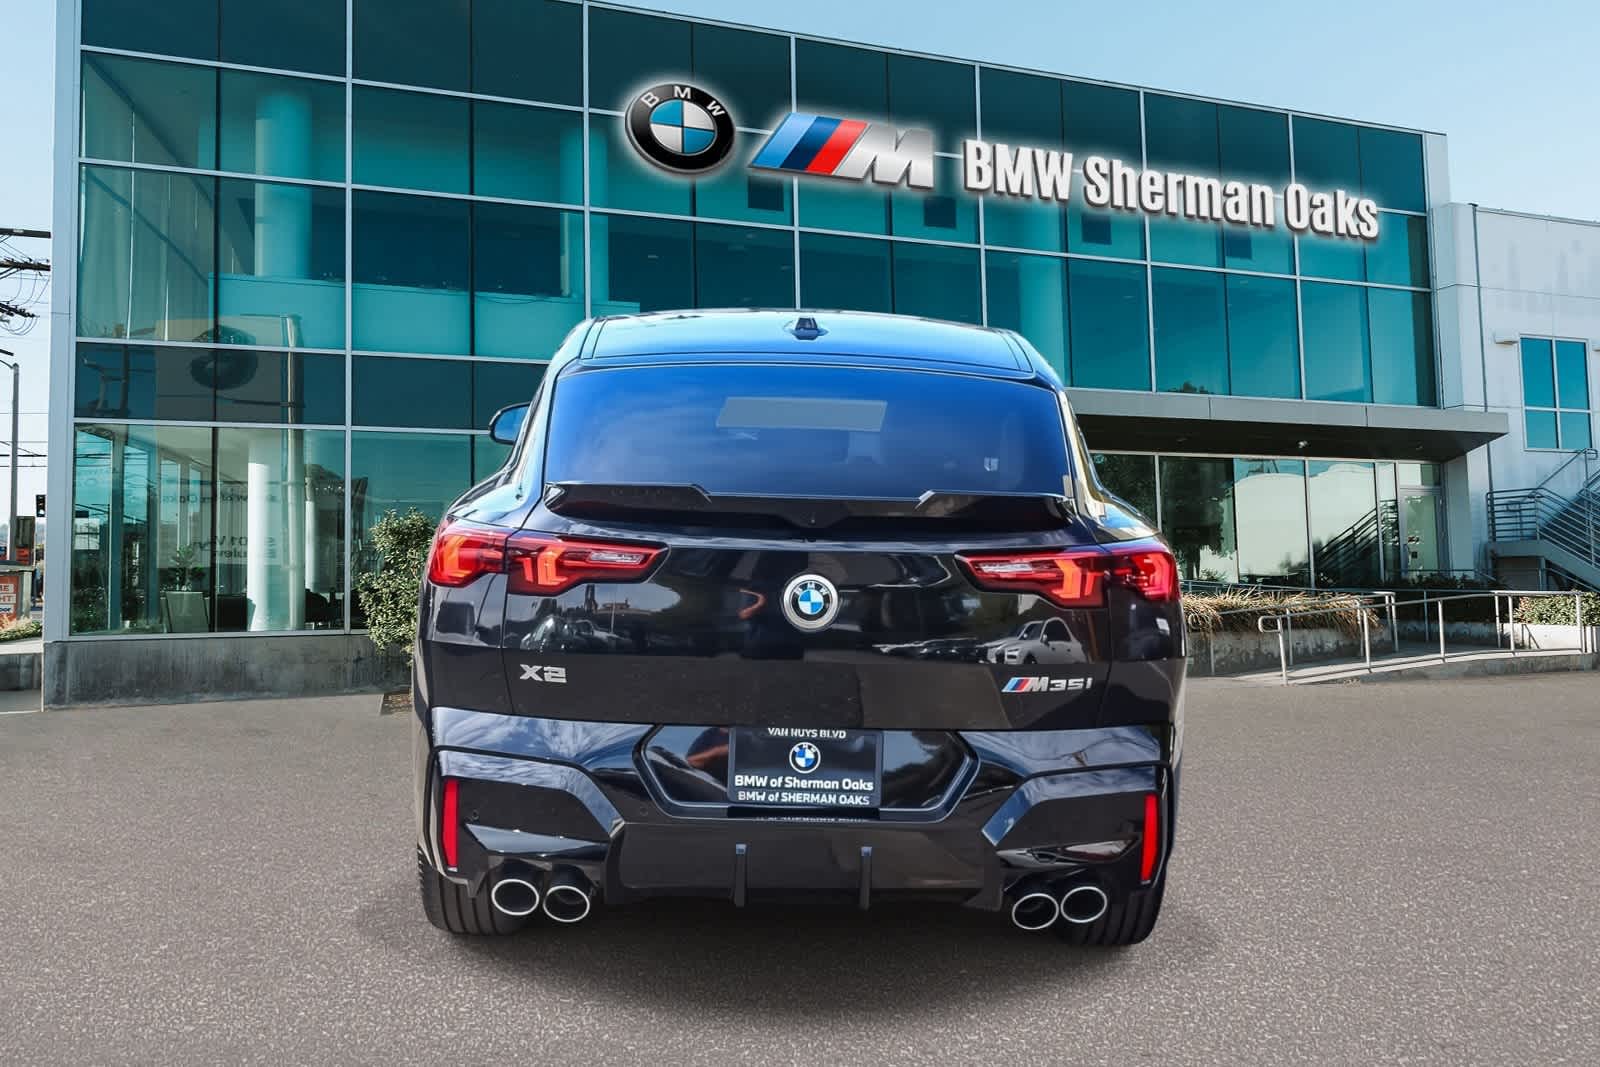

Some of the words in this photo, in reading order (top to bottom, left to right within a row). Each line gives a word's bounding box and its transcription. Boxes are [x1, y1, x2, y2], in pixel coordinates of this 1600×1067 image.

[640, 84, 726, 118] BMW
[963, 138, 1073, 204] BMW
[1083, 154, 1275, 228] Sherman
[1284, 183, 1380, 241] Oaks
[519, 663, 567, 683] X2
[767, 727, 789, 736] VAN
[790, 728, 818, 738] NUYS
[819, 729, 847, 739] BLVD
[734, 775, 767, 787] BMW
[770, 777, 783, 787] of
[785, 776, 840, 790] Sherman
[842, 778, 874, 791] Oaks
[737, 791, 766, 801] BMW
[768, 792, 780, 801] of
[781, 792, 837, 804] SHERMAN
[839, 794, 870, 805] OAKS
